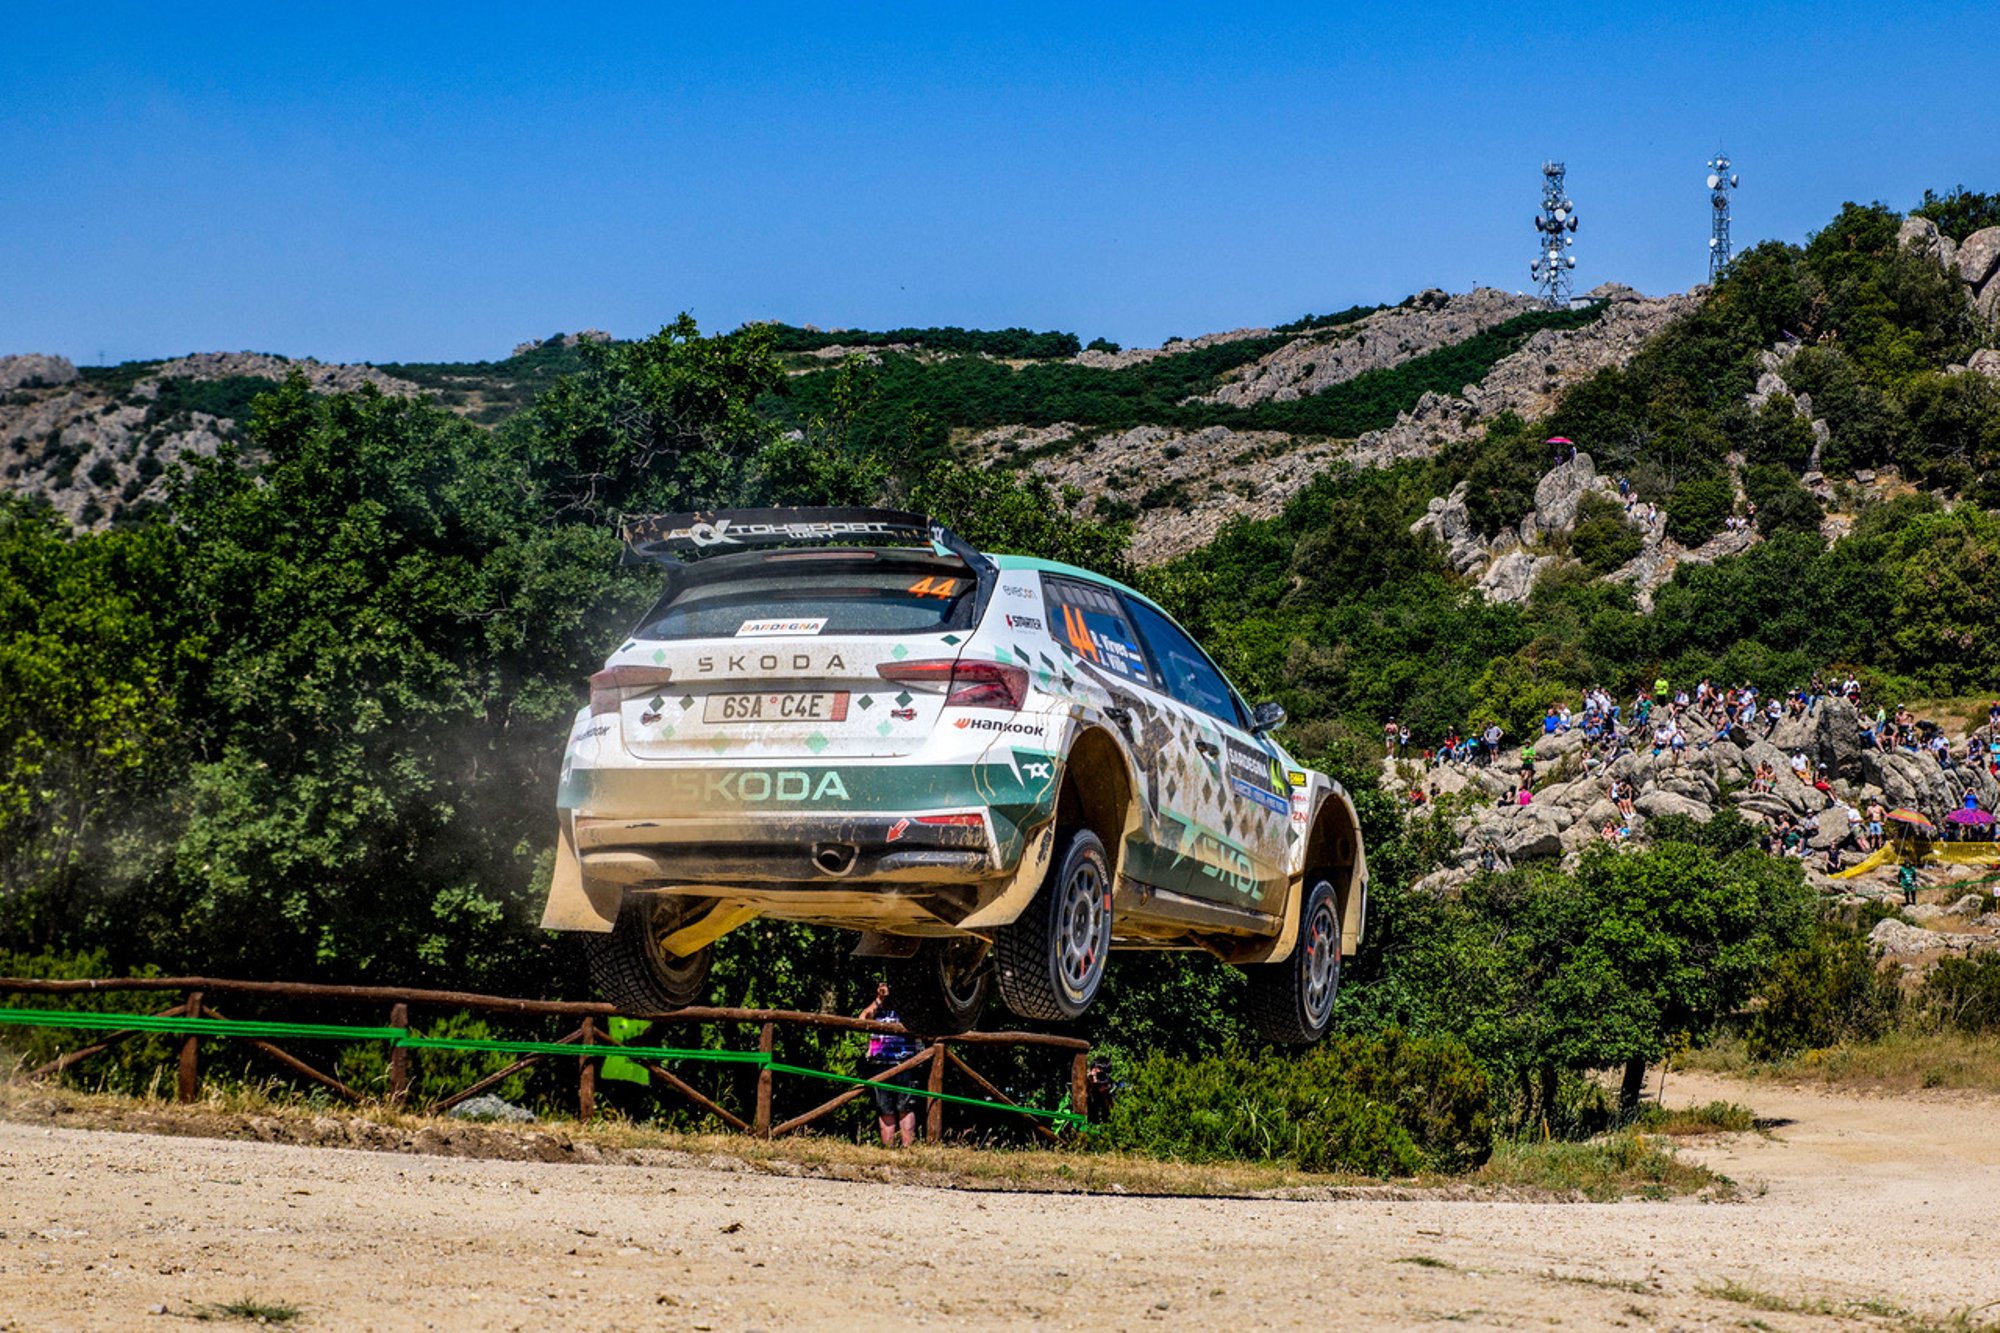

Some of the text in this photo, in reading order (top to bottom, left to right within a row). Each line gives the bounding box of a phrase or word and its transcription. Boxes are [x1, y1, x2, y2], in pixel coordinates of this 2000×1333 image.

[908, 576, 956, 600] 44
[741, 622, 820, 633] SARDEGNA
[1062, 603, 1099, 663] 44
[698, 654, 846, 672] SKODA
[723, 695, 824, 718] 6SA C4E
[1270, 757, 1287, 798] 44
